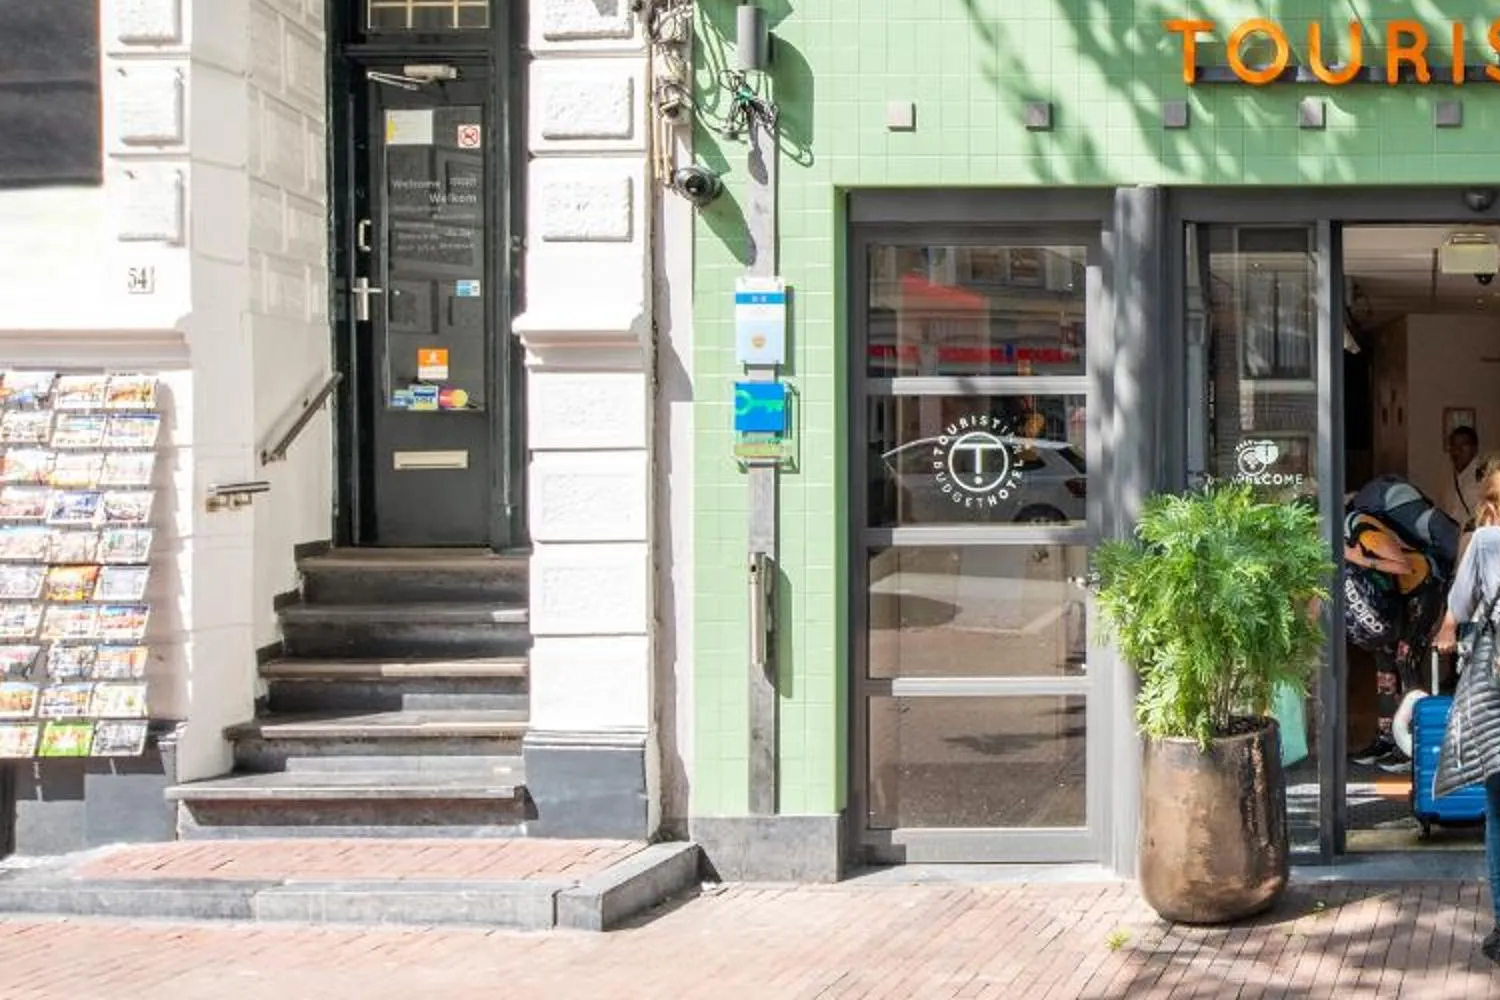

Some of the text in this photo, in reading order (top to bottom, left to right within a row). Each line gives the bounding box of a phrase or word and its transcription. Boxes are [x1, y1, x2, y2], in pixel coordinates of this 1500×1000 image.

[933, 415, 1001, 457] TOURIST
[933, 461, 983, 509] BUDGET
[987, 459, 1025, 507] HOTEL
[1345, 577, 1383, 633] adidas
